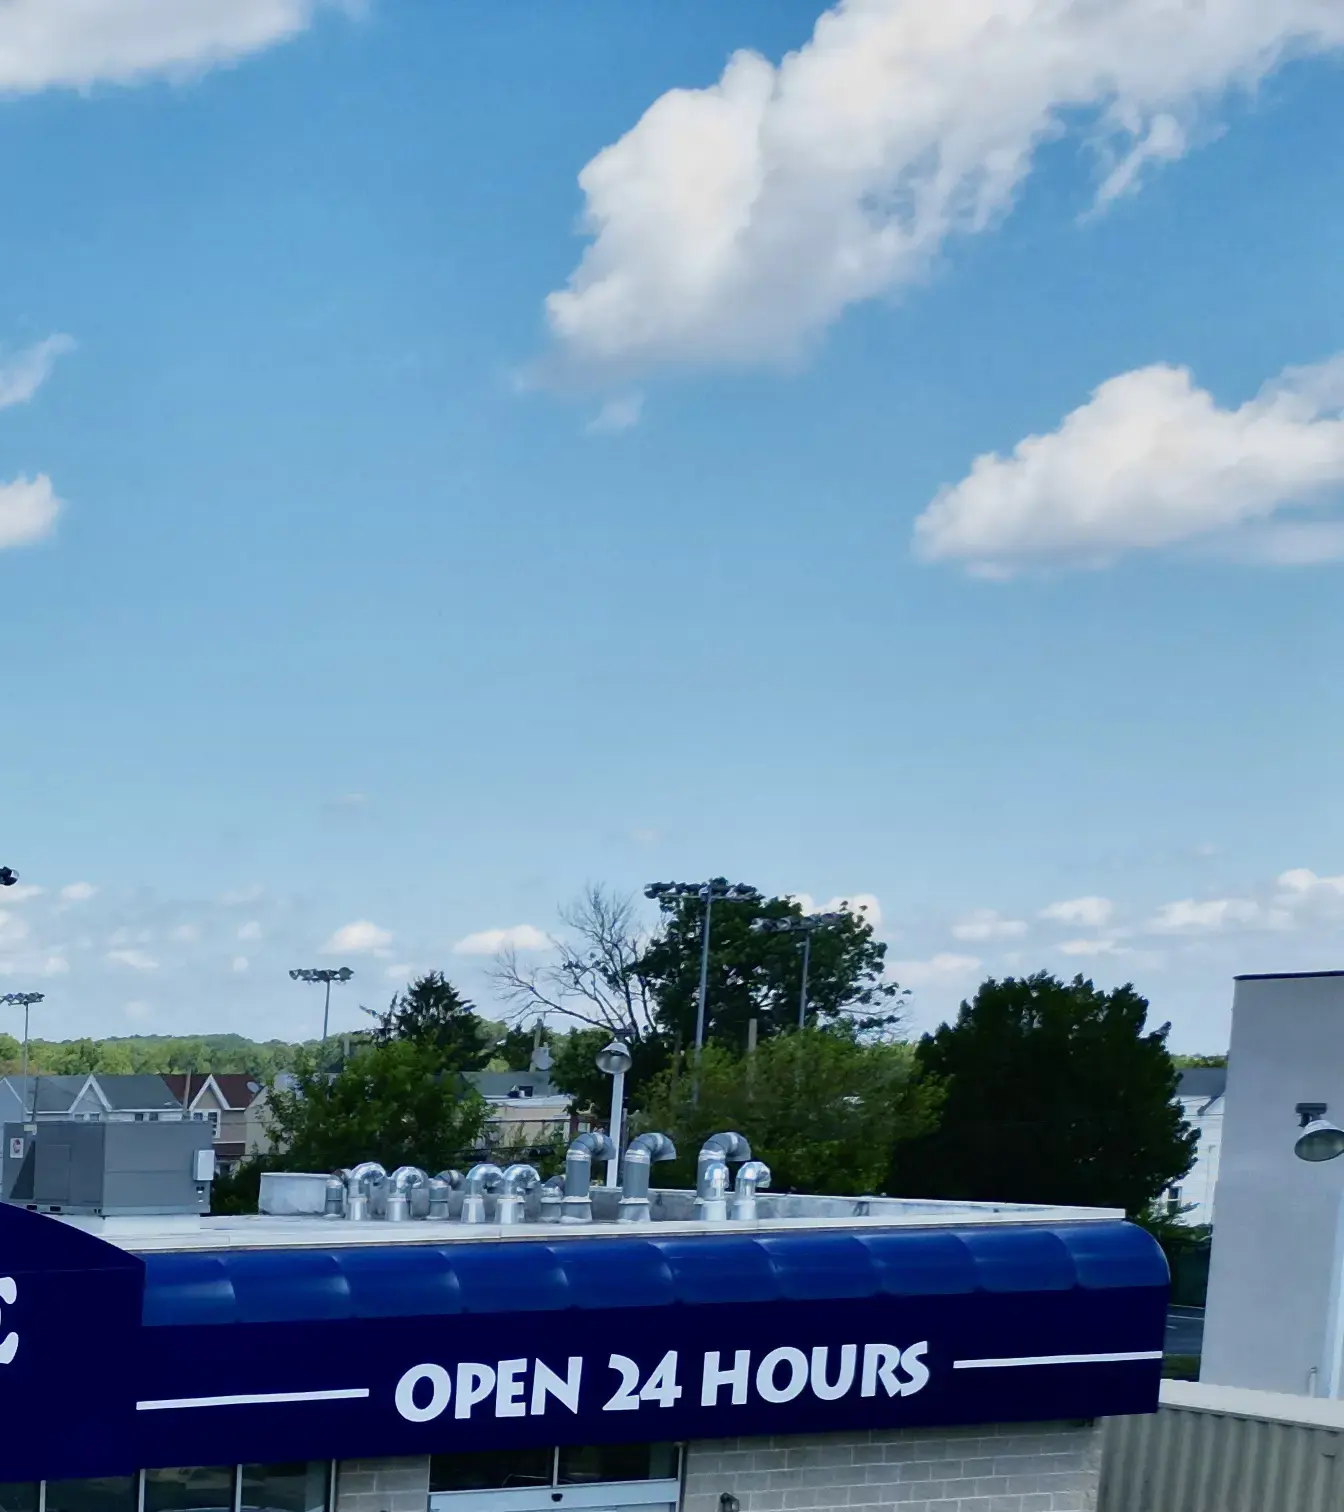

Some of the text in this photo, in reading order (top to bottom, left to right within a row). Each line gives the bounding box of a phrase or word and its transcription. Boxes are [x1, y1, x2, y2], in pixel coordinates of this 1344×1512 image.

[394, 1340, 930, 1423] OPEN 24 HOURS
